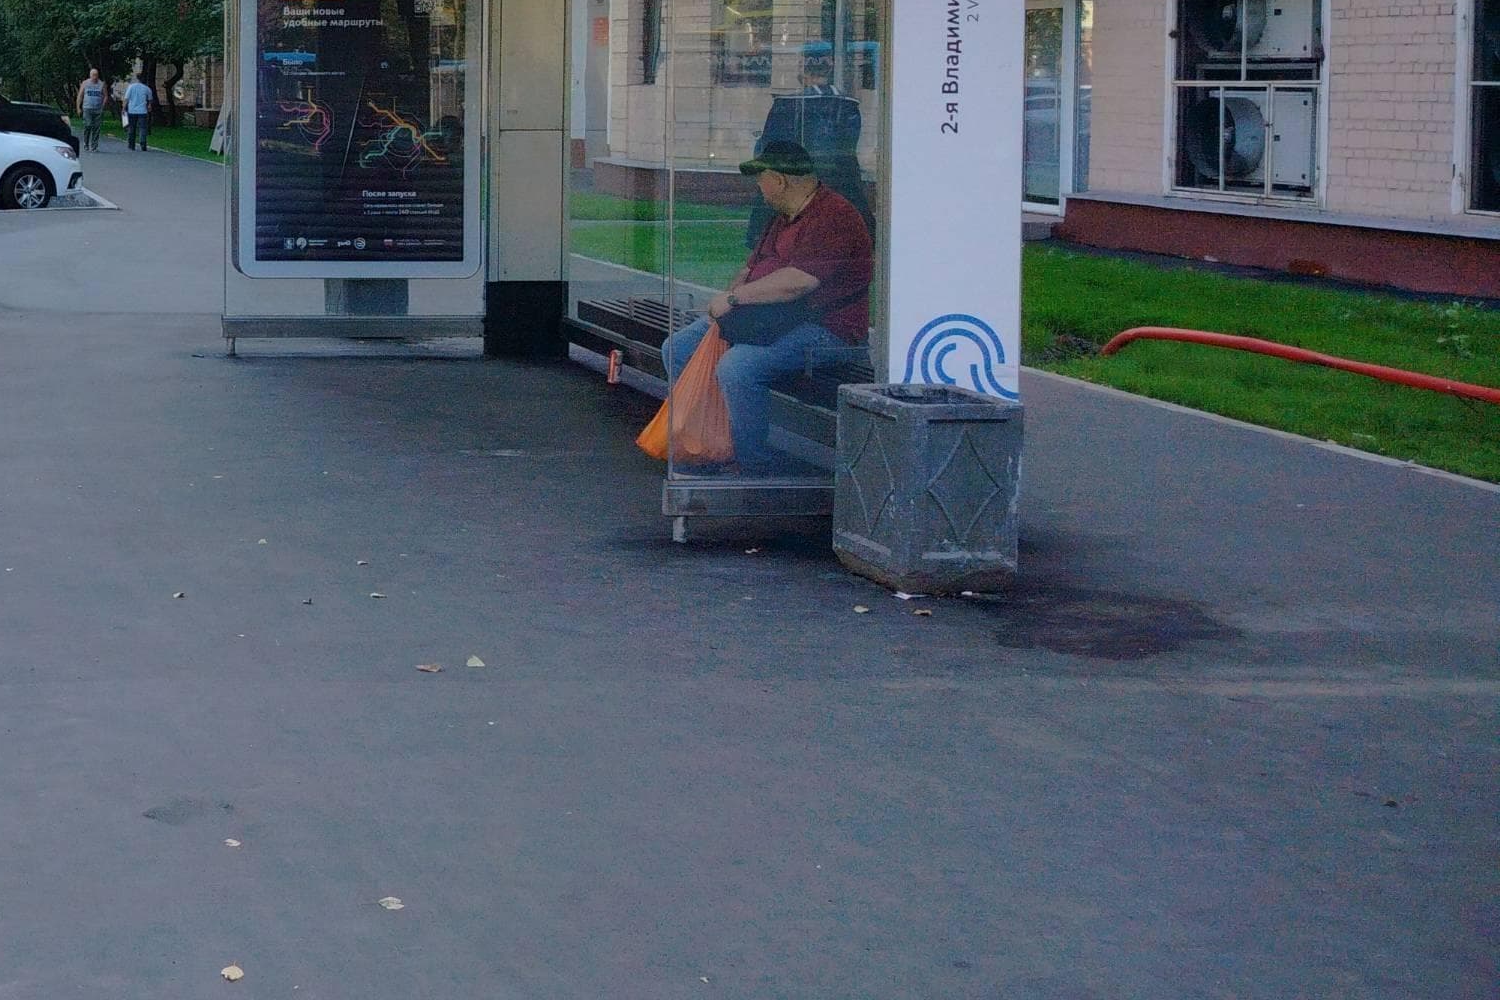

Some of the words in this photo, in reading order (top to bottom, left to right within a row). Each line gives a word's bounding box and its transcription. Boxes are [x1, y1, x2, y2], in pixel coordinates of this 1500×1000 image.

[283, 7, 311, 16] Ваши
[313, 8, 345, 16] новые
[283, 18, 327, 28] удобные
[329, 19, 384, 28] маршруты
[967, 13, 979, 23] 2
[941, 102, 958, 134] 2-я
[387, 191, 417, 199] запуска
